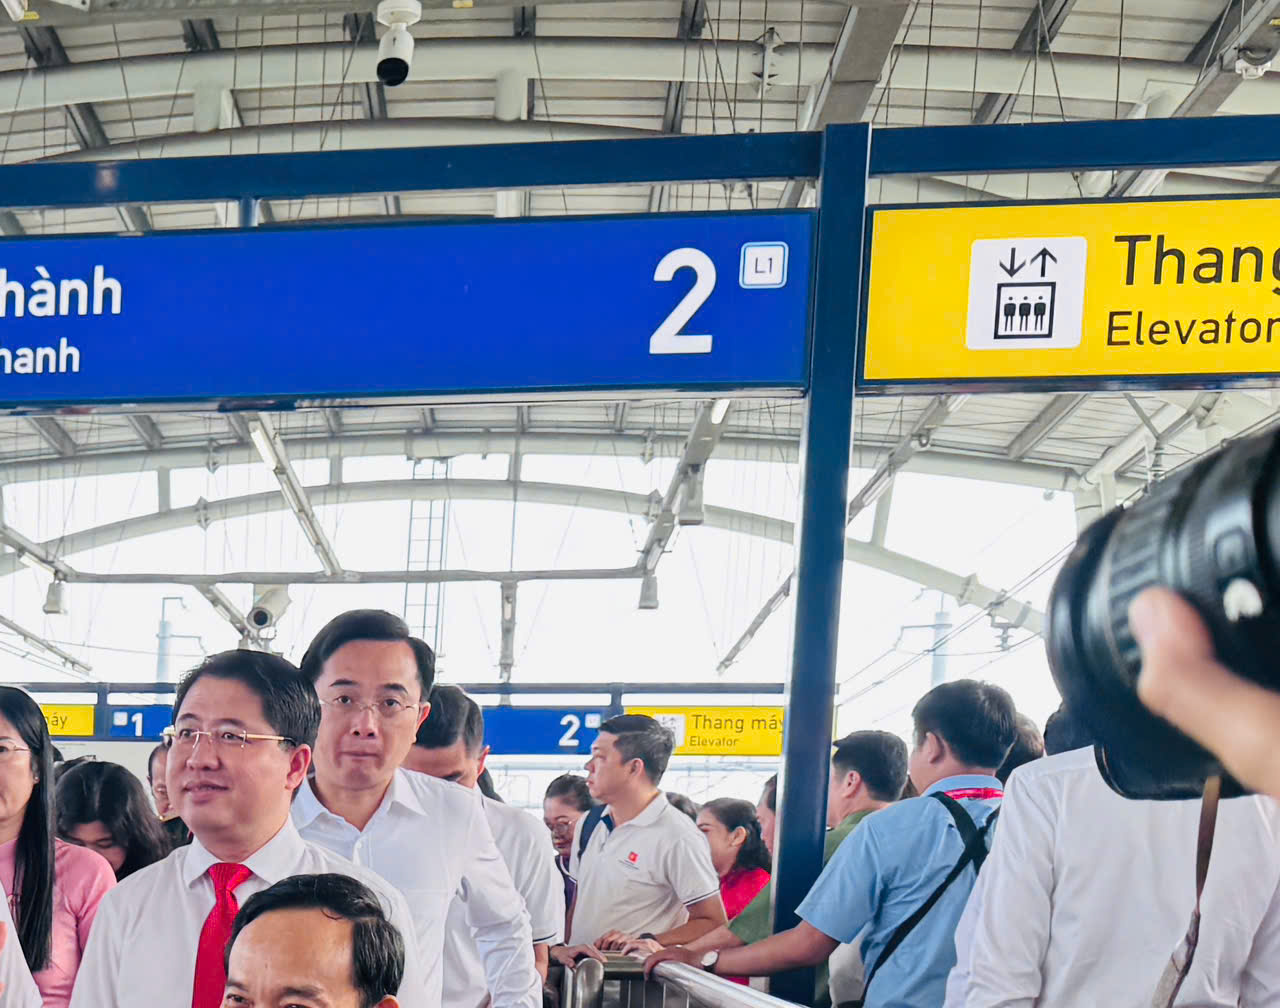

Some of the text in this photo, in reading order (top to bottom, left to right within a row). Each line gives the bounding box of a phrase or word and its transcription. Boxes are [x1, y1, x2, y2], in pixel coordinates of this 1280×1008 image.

[754, 256, 774, 275] L1
[649, 247, 717, 355] 2
[131, 712, 143, 737] 1
[558, 714, 581, 747] 2
[691, 714, 745, 733] Thang
[689, 736, 740, 747] Elevator
